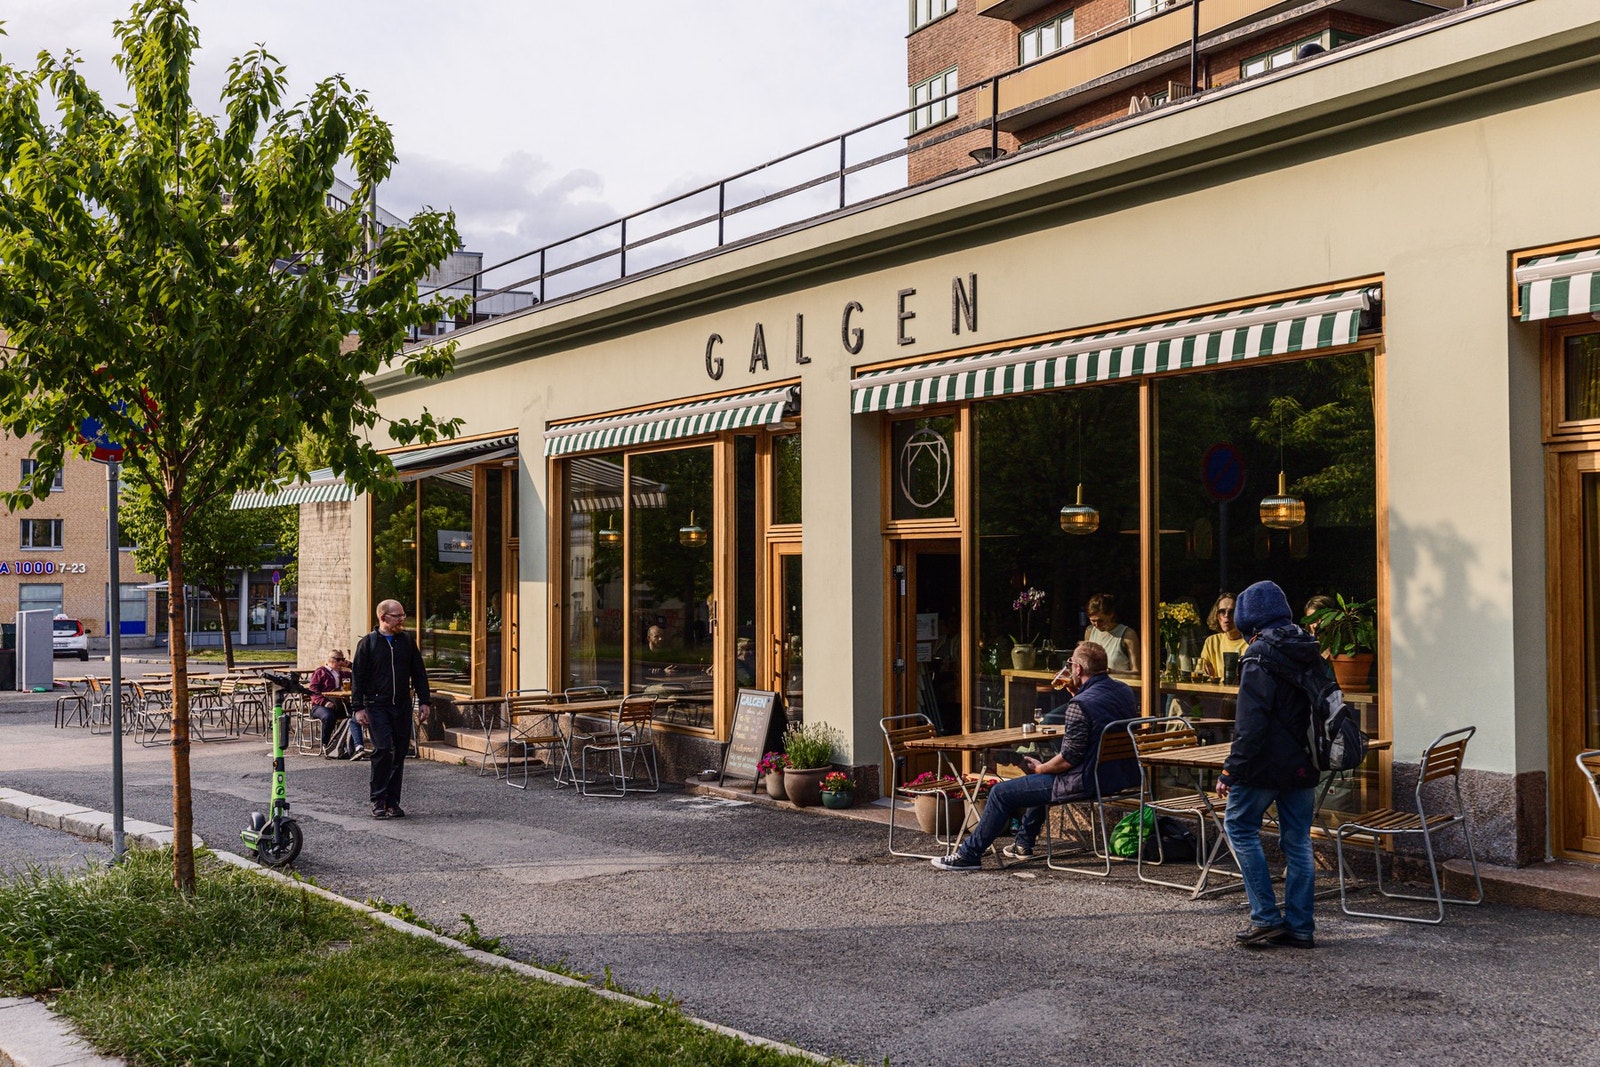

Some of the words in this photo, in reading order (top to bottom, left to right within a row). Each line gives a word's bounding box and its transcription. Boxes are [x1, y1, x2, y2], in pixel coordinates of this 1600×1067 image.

[705, 272, 977, 380] GALGEN
[15, 561, 54, 575] 1000
[59, 562, 86, 574] 7-23
